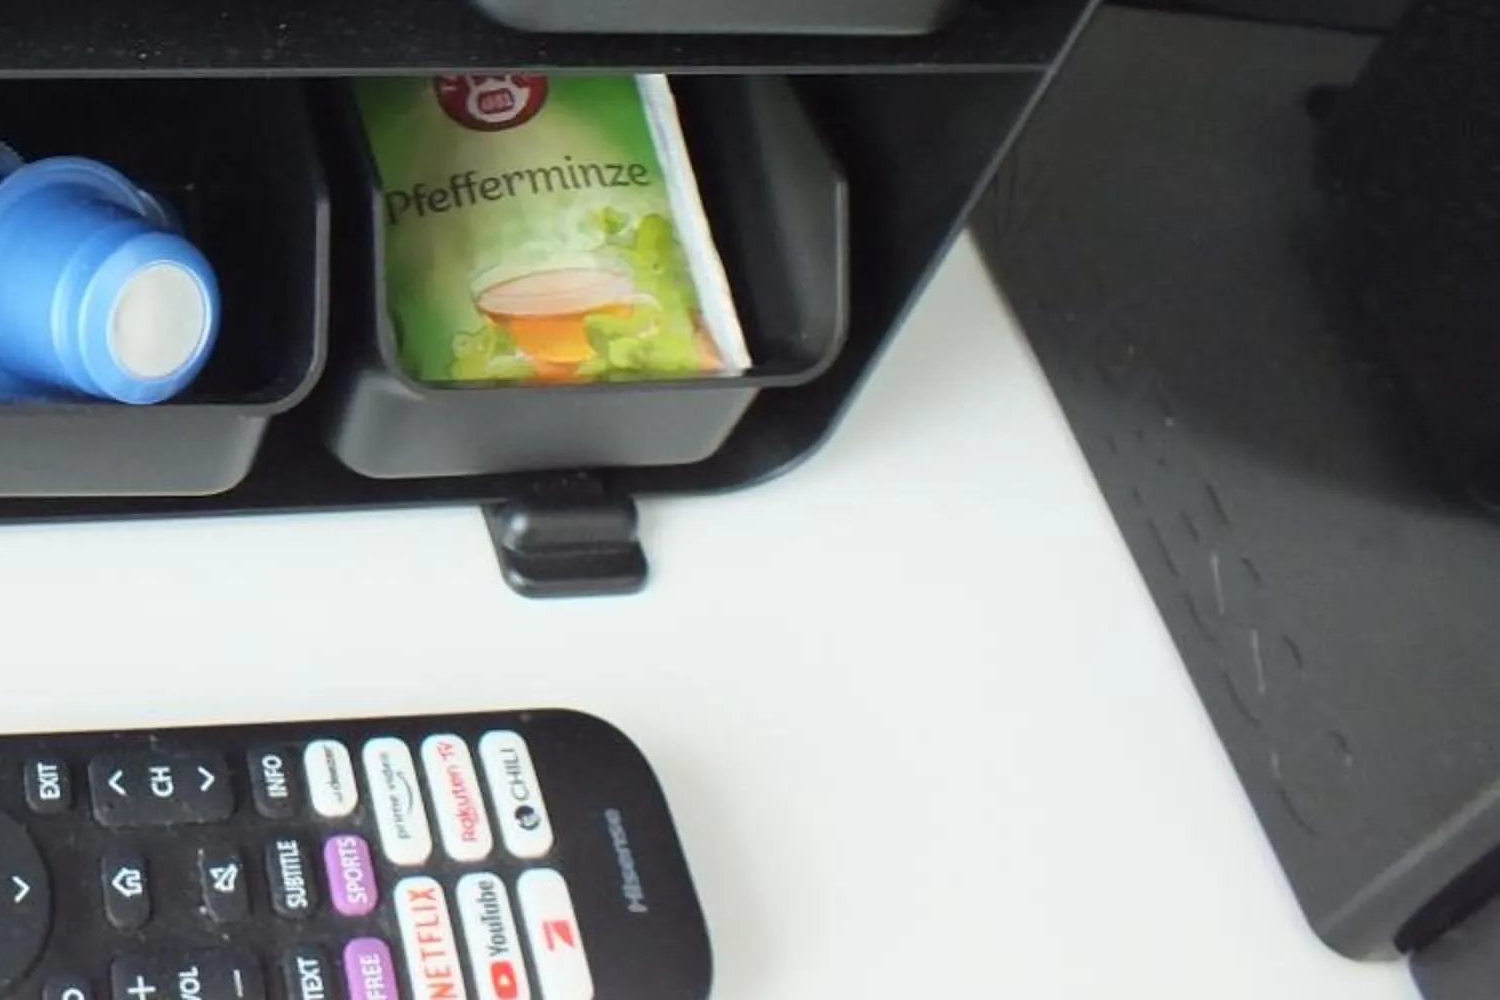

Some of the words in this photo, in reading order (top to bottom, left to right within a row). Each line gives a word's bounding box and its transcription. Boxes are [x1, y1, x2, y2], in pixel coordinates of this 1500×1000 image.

[384, 155, 651, 225] Pfefferminze
[37, 762, 62, 801] EXIT
[149, 766, 175, 798] CH
[261, 754, 289, 799] INFO
[447, 764, 479, 843] Rakuten
[276, 839, 309, 910] SUBTITLE
[336, 836, 368, 905] SPORTS
[406, 886, 458, 1000] NETFLIX
[477, 880, 510, 957] YouTube
[296, 956, 326, 1000] TEXT
[359, 953, 388, 1000] FREE
